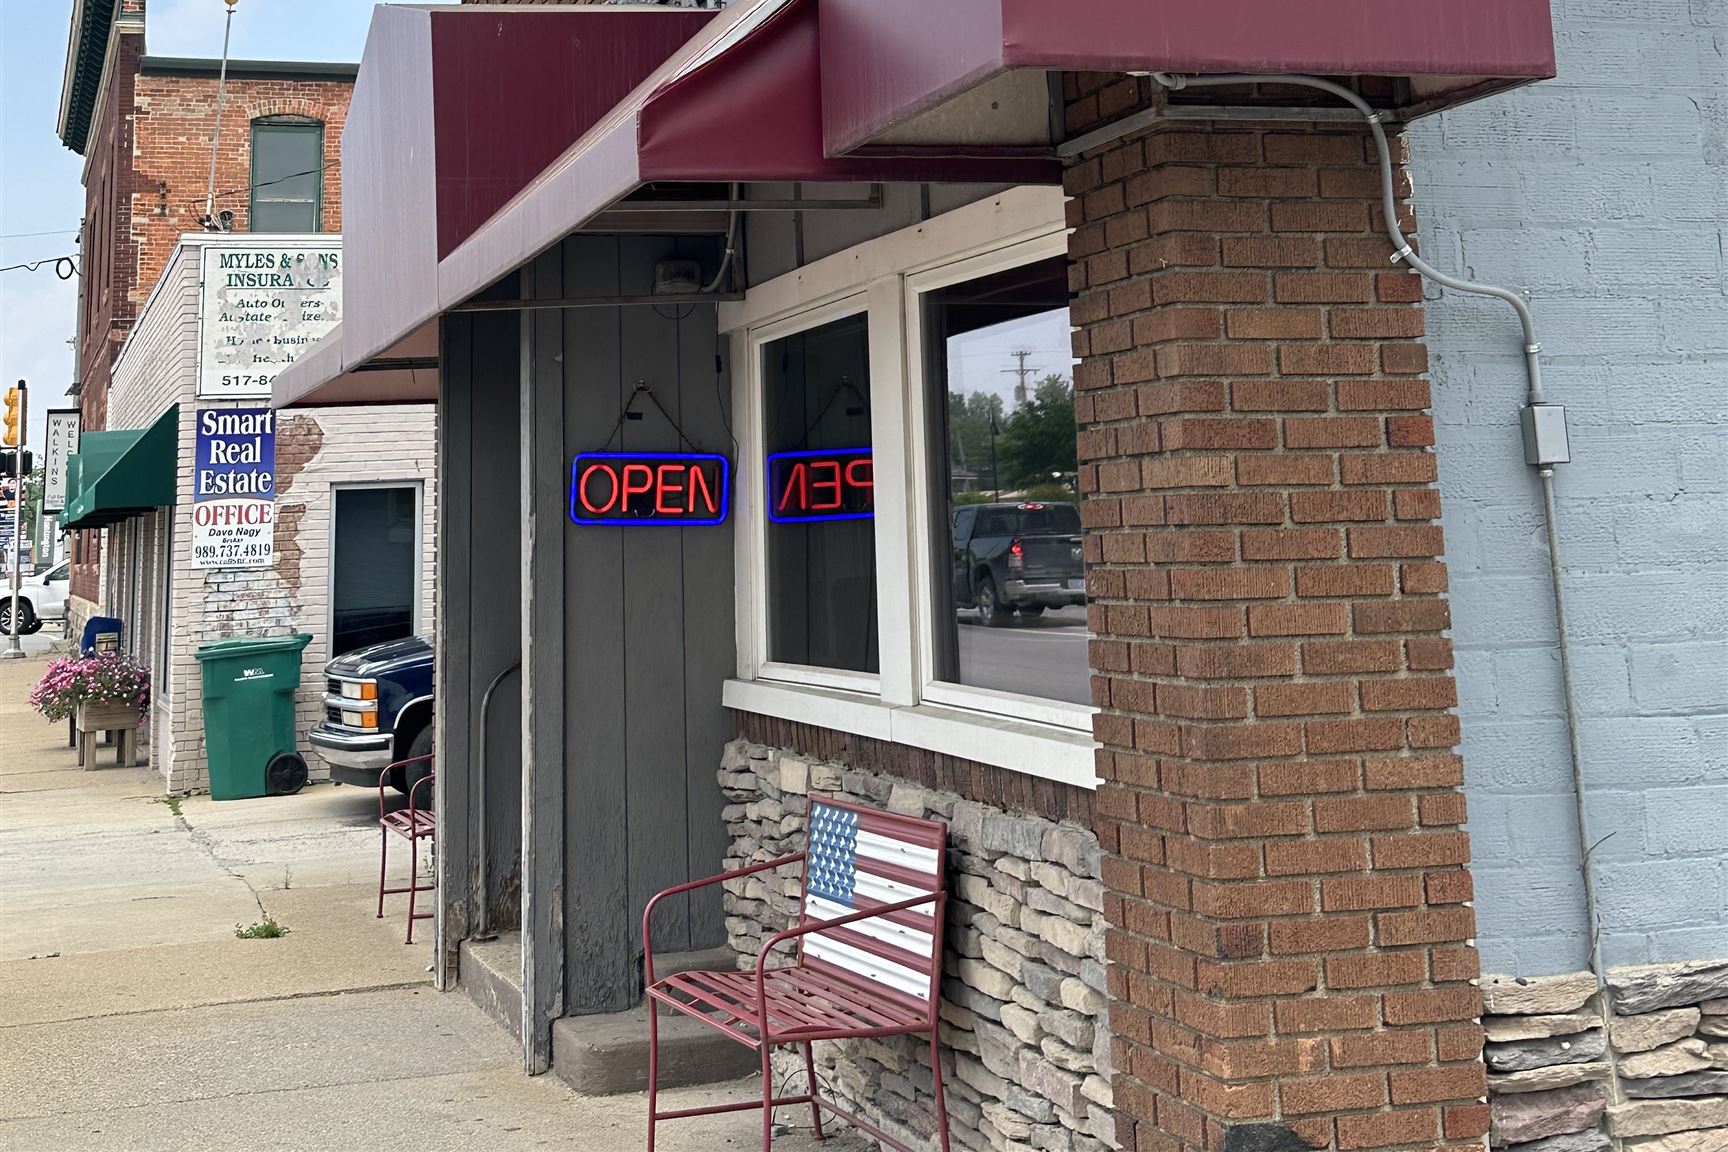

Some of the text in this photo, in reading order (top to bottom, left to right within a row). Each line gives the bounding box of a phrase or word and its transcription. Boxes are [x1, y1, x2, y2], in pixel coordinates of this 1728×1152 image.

[219, 253, 338, 270] MYLES & SNS
[225, 273, 330, 287] INSURA
[201, 410, 273, 436] Smart
[209, 436, 262, 464] Real
[199, 468, 272, 494] Estate
[580, 463, 720, 514] OPEN
[195, 504, 272, 527] OFFICE
[235, 527, 261, 537] Nagy
[195, 543, 271, 559] 989.737.4819
